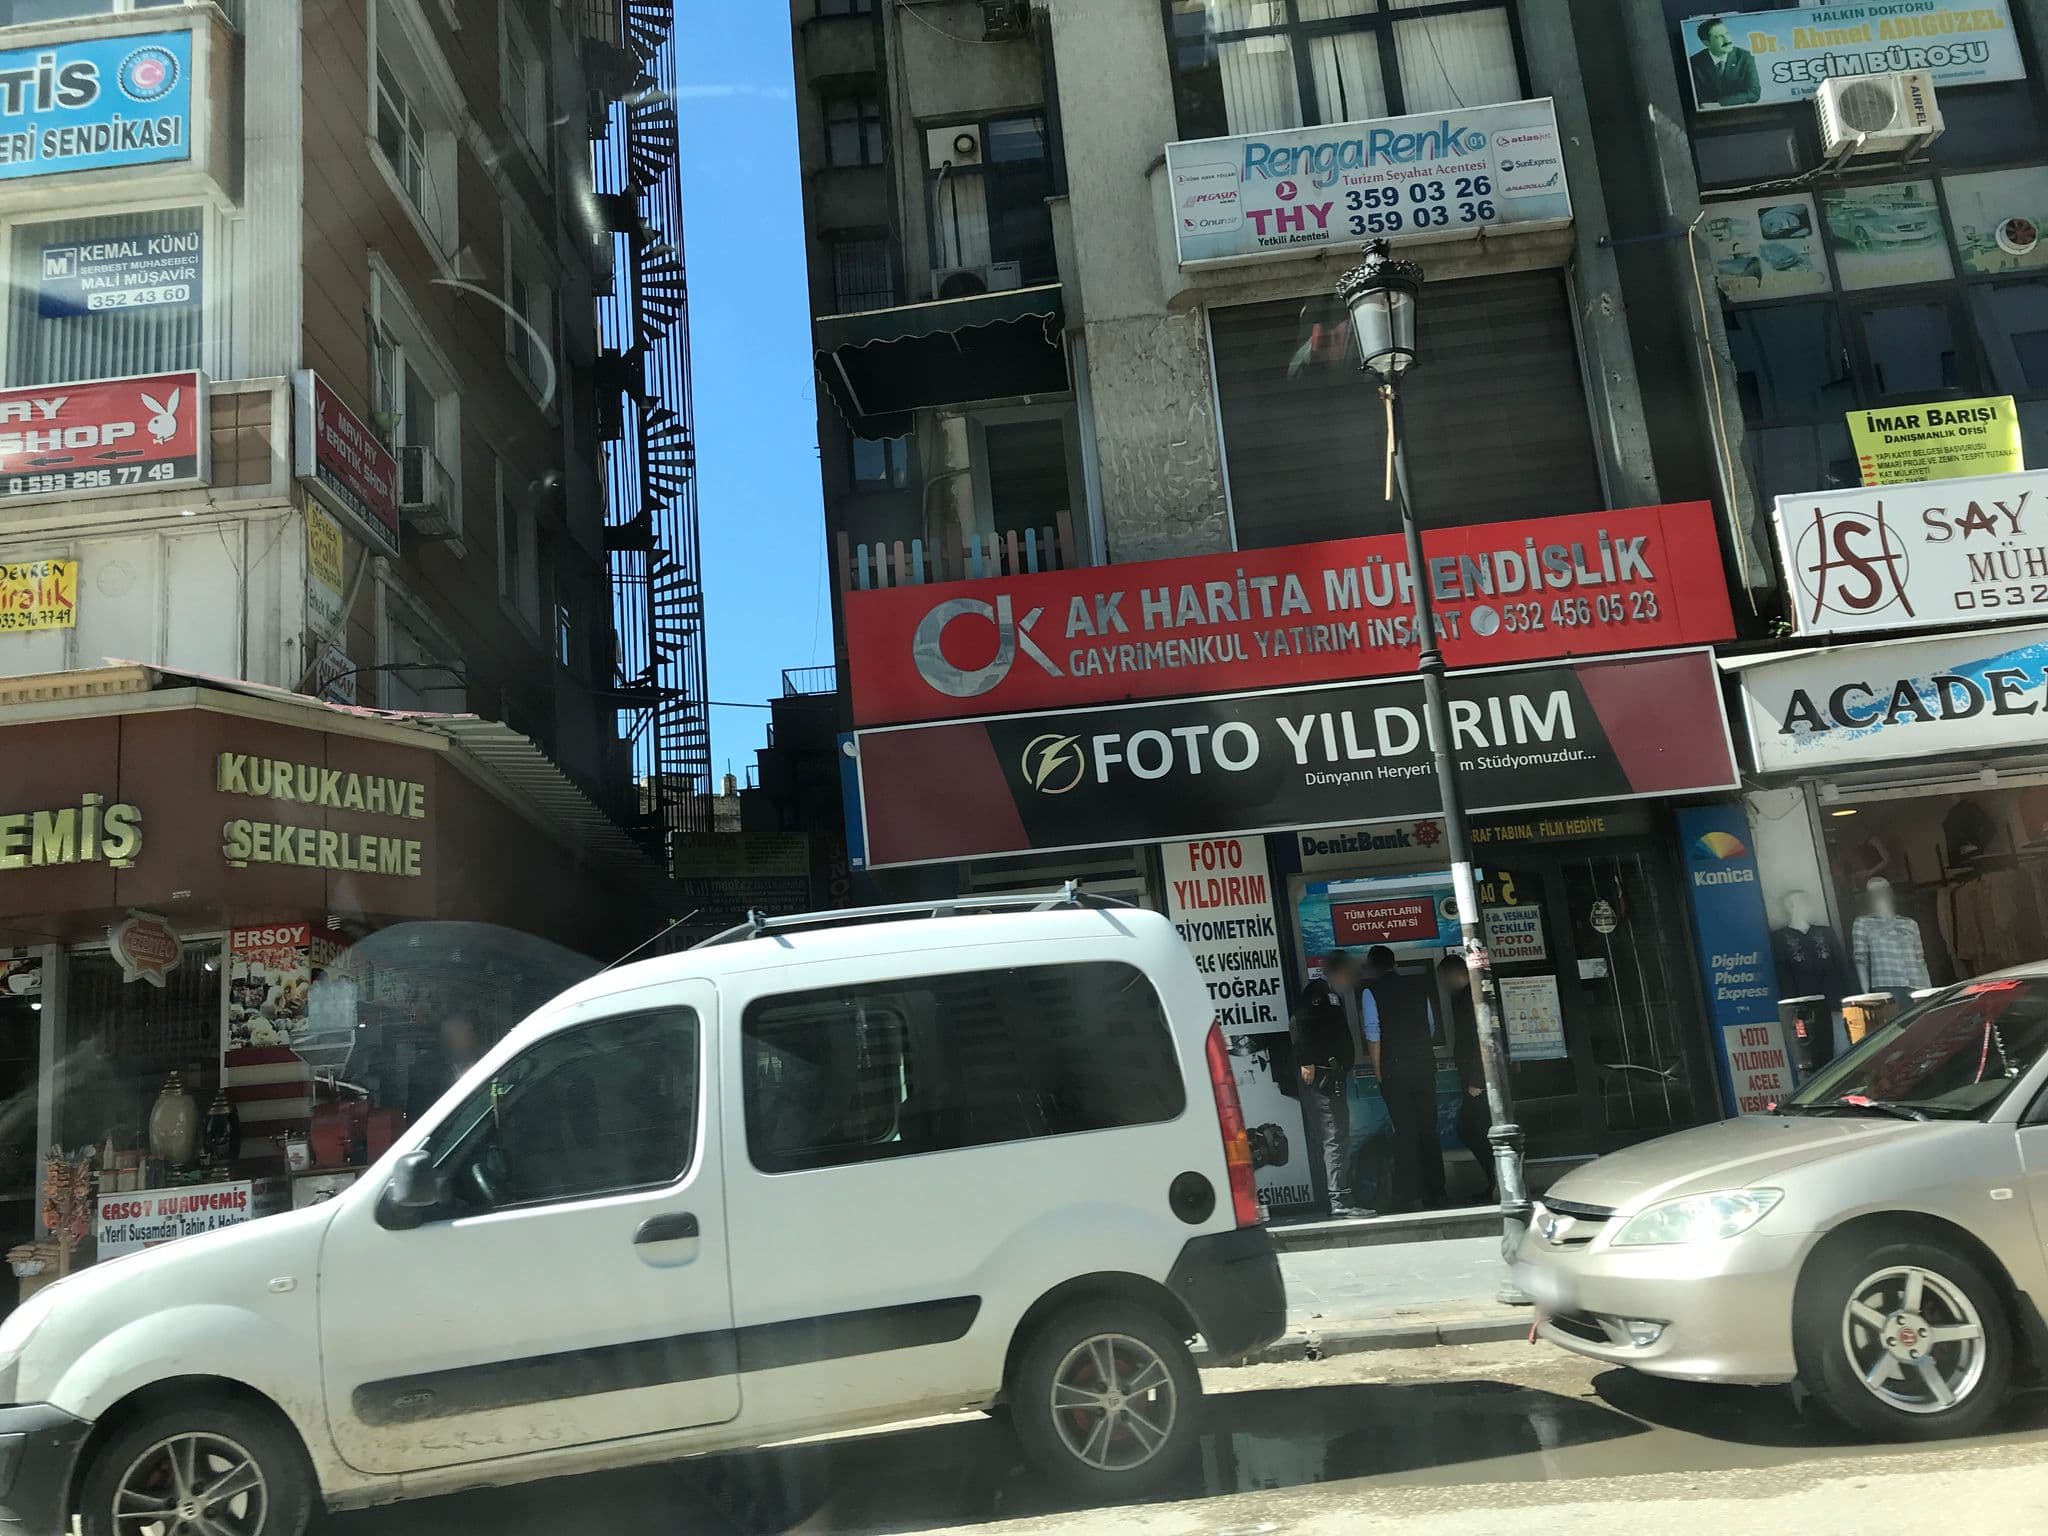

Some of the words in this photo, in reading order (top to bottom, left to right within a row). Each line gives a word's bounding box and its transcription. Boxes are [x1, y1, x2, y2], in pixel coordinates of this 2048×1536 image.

[1812, 8, 1864, 23] HALKIN
[1869, 2, 1935, 17] DOKTORU
[1793, 22, 1872, 49] Ahmet
[1879, 9, 2005, 40] ADIGÜZEL
[1772, 51, 1865, 84] SEÇİM
[1866, 40, 1990, 74] BÜROSU
[1910, 86, 1927, 127] AIRFEL
[42, 113, 182, 160] SENDİKASI
[1342, 173, 1384, 186] Turizm
[1386, 166, 1432, 183] Seyahat
[1436, 160, 1486, 175] Acentesi
[1515, 158, 1557, 169] SunExpress
[1196, 191, 1238, 202] PEGASUS
[1345, 186, 1399, 211] 359
[1409, 181, 1446, 203] 03
[1455, 175, 1492, 199] 26
[1245, 202, 1334, 236] THY
[1348, 211, 1403, 236] 359
[1412, 206, 1449, 228] 03
[1458, 200, 1495, 223] 36
[80, 241, 143, 262] KEMAL
[148, 232, 199, 255] KÜNÜ
[1257, 236, 1287, 247] Yetkili
[1289, 231, 1330, 244] Acentesi
[80, 262, 127, 275] SERBEST
[81, 273, 120, 291] MALİ
[124, 266, 196, 286] MÜŞAVİR
[92, 293, 128, 309] 352
[133, 290, 157, 304] 43
[163, 287, 187, 301] 60
[1867, 412, 1920, 433] İMAR
[1926, 406, 1998, 426] BARIŞI
[0, 421, 136, 454] SHOP
[1884, 430, 1956, 444] DANIŞMANLIK
[9, 478, 23, 494] 0
[28, 474, 67, 493] 533
[72, 470, 111, 489] 296
[116, 466, 143, 484] 77
[147, 463, 175, 480] 49
[1879, 470, 1893, 478] KAT
[1922, 490, 2033, 544] SAY
[1065, 591, 1129, 638] AK
[1140, 568, 1312, 630] HARİTA
[1323, 529, 1654, 610] MÜHENDİSLİK
[1954, 584, 2048, 610] 0532
[1253, 621, 1360, 658] YATIRIM
[1503, 602, 1544, 632] 532
[1550, 597, 1592, 627] 456
[1596, 594, 1625, 622] 05
[1631, 589, 1659, 619] 23
[1778, 667, 2048, 735] ACADE
[1093, 721, 1260, 783] FOTO
[1275, 690, 1577, 766] YILDIRIM
[1305, 768, 1374, 787] Dünyanın
[1377, 761, 1430, 781] Heryeri
[1477, 749, 1597, 771] Stüdyomuzdur...
[217, 751, 426, 818] KURUKAHVE
[1566, 816, 1606, 835] HEDİYE
[1189, 839, 1242, 872] FOTO
[1301, 829, 1411, 857] DenizBank
[1694, 866, 1753, 886] Konica
[1174, 875, 1267, 911] YILDIRIM
[1344, 908, 1366, 920] TÜM
[1367, 905, 1422, 918] KARTLARIN
[233, 926, 306, 949] ERSOY
[1352, 920, 1385, 932] ORTAK
[1491, 945, 1543, 958] YILDIRIM
[1495, 934, 1534, 946] FOTO
[1217, 946, 1279, 972] VESİKALIK
[1711, 951, 1758, 970] Digital
[1714, 971, 1755, 985] Photo
[1717, 986, 1769, 1001] Express
[1732, 1049, 1785, 1072] YILDIRIM
[1748, 1073, 1781, 1092] ACELE
[129, 1222, 177, 1242] Susamdan
